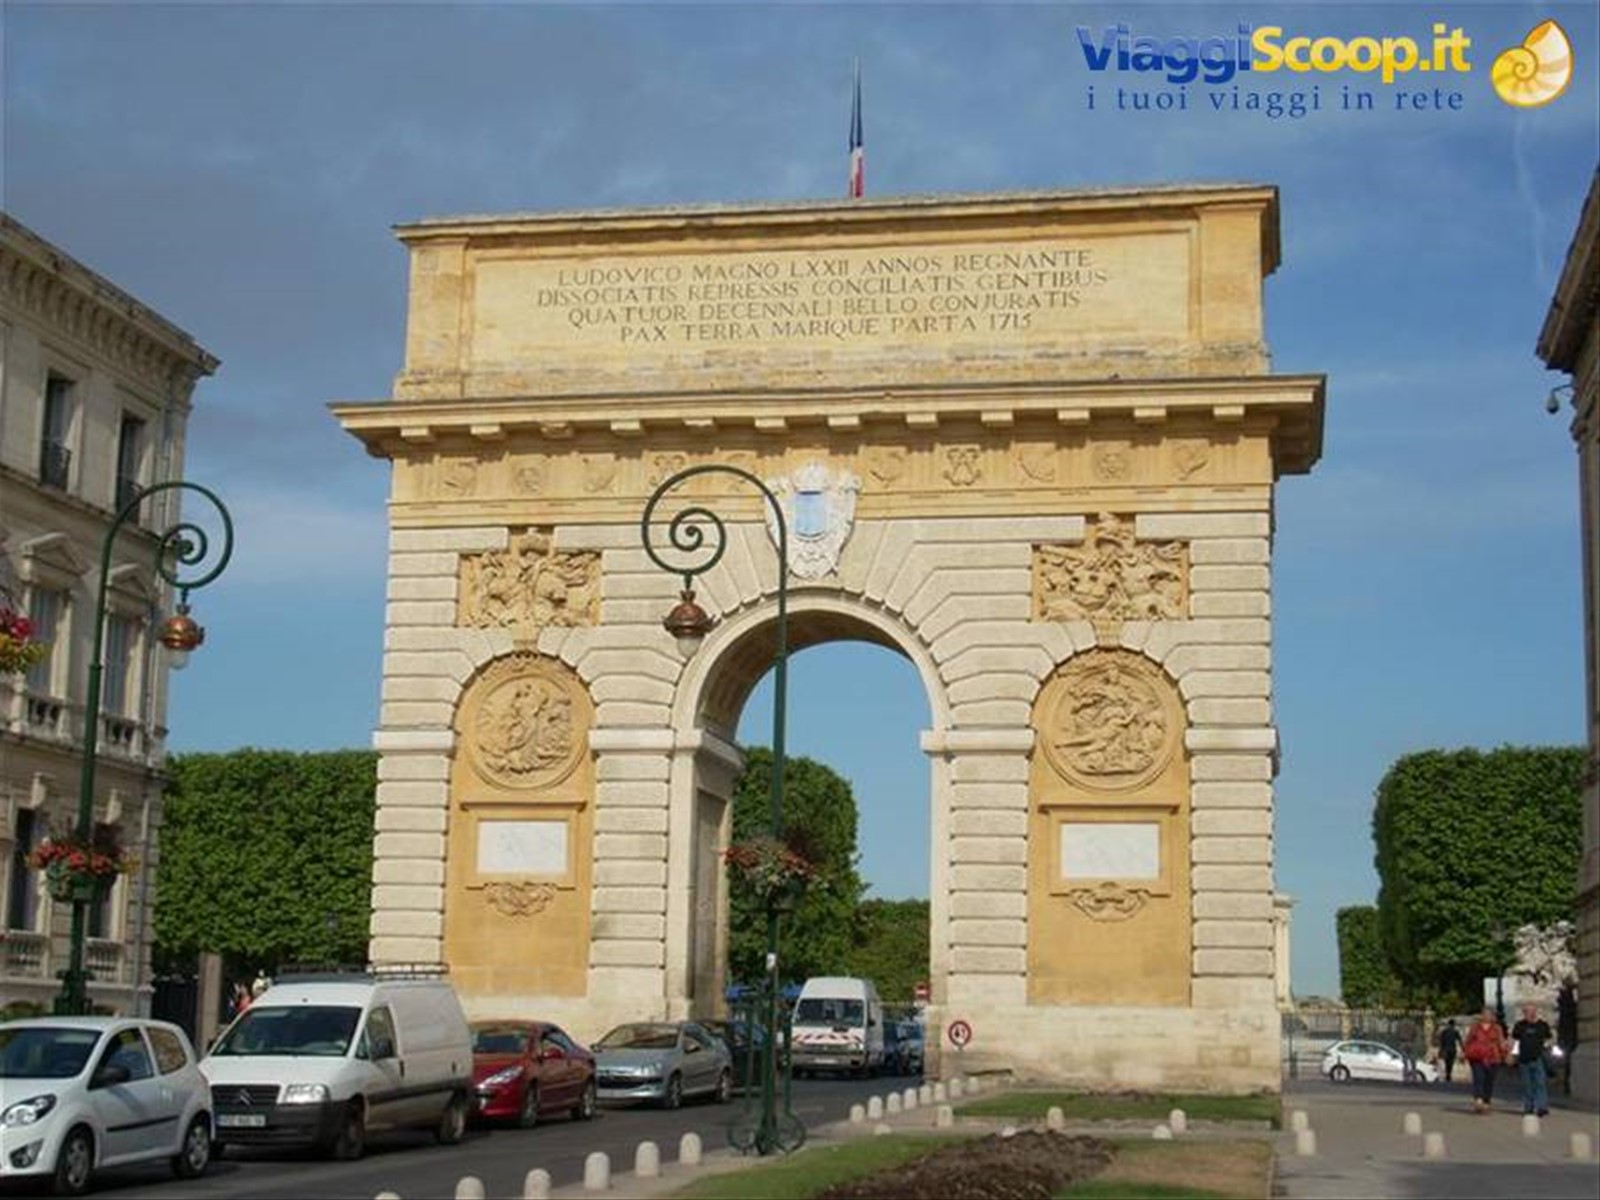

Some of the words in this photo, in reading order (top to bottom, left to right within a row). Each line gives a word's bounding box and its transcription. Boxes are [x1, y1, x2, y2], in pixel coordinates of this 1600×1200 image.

[558, 265, 683, 287] LUDOVICO
[692, 261, 780, 282] MAGNO
[790, 259, 849, 279] LXXII
[861, 256, 943, 275] ANNOS
[953, 249, 1093, 272] REGNANTE
[537, 286, 679, 308] DISSOCIATIS
[688, 281, 801, 301] REPRESSIS
[811, 275, 966, 297] CONCILIATIS
[976, 269, 1108, 291] GENTIBUS
[568, 304, 688, 330] QUATUOR
[843, 296, 918, 315] BELLO
[929, 290, 1082, 313] CONJURATIS
[620, 325, 668, 343] PAX
[679, 321, 762, 341] TERRA
[771, 317, 880, 341] MARIQUE
[889, 315, 978, 335] PARTA
[988, 312, 1032, 331] 1715
